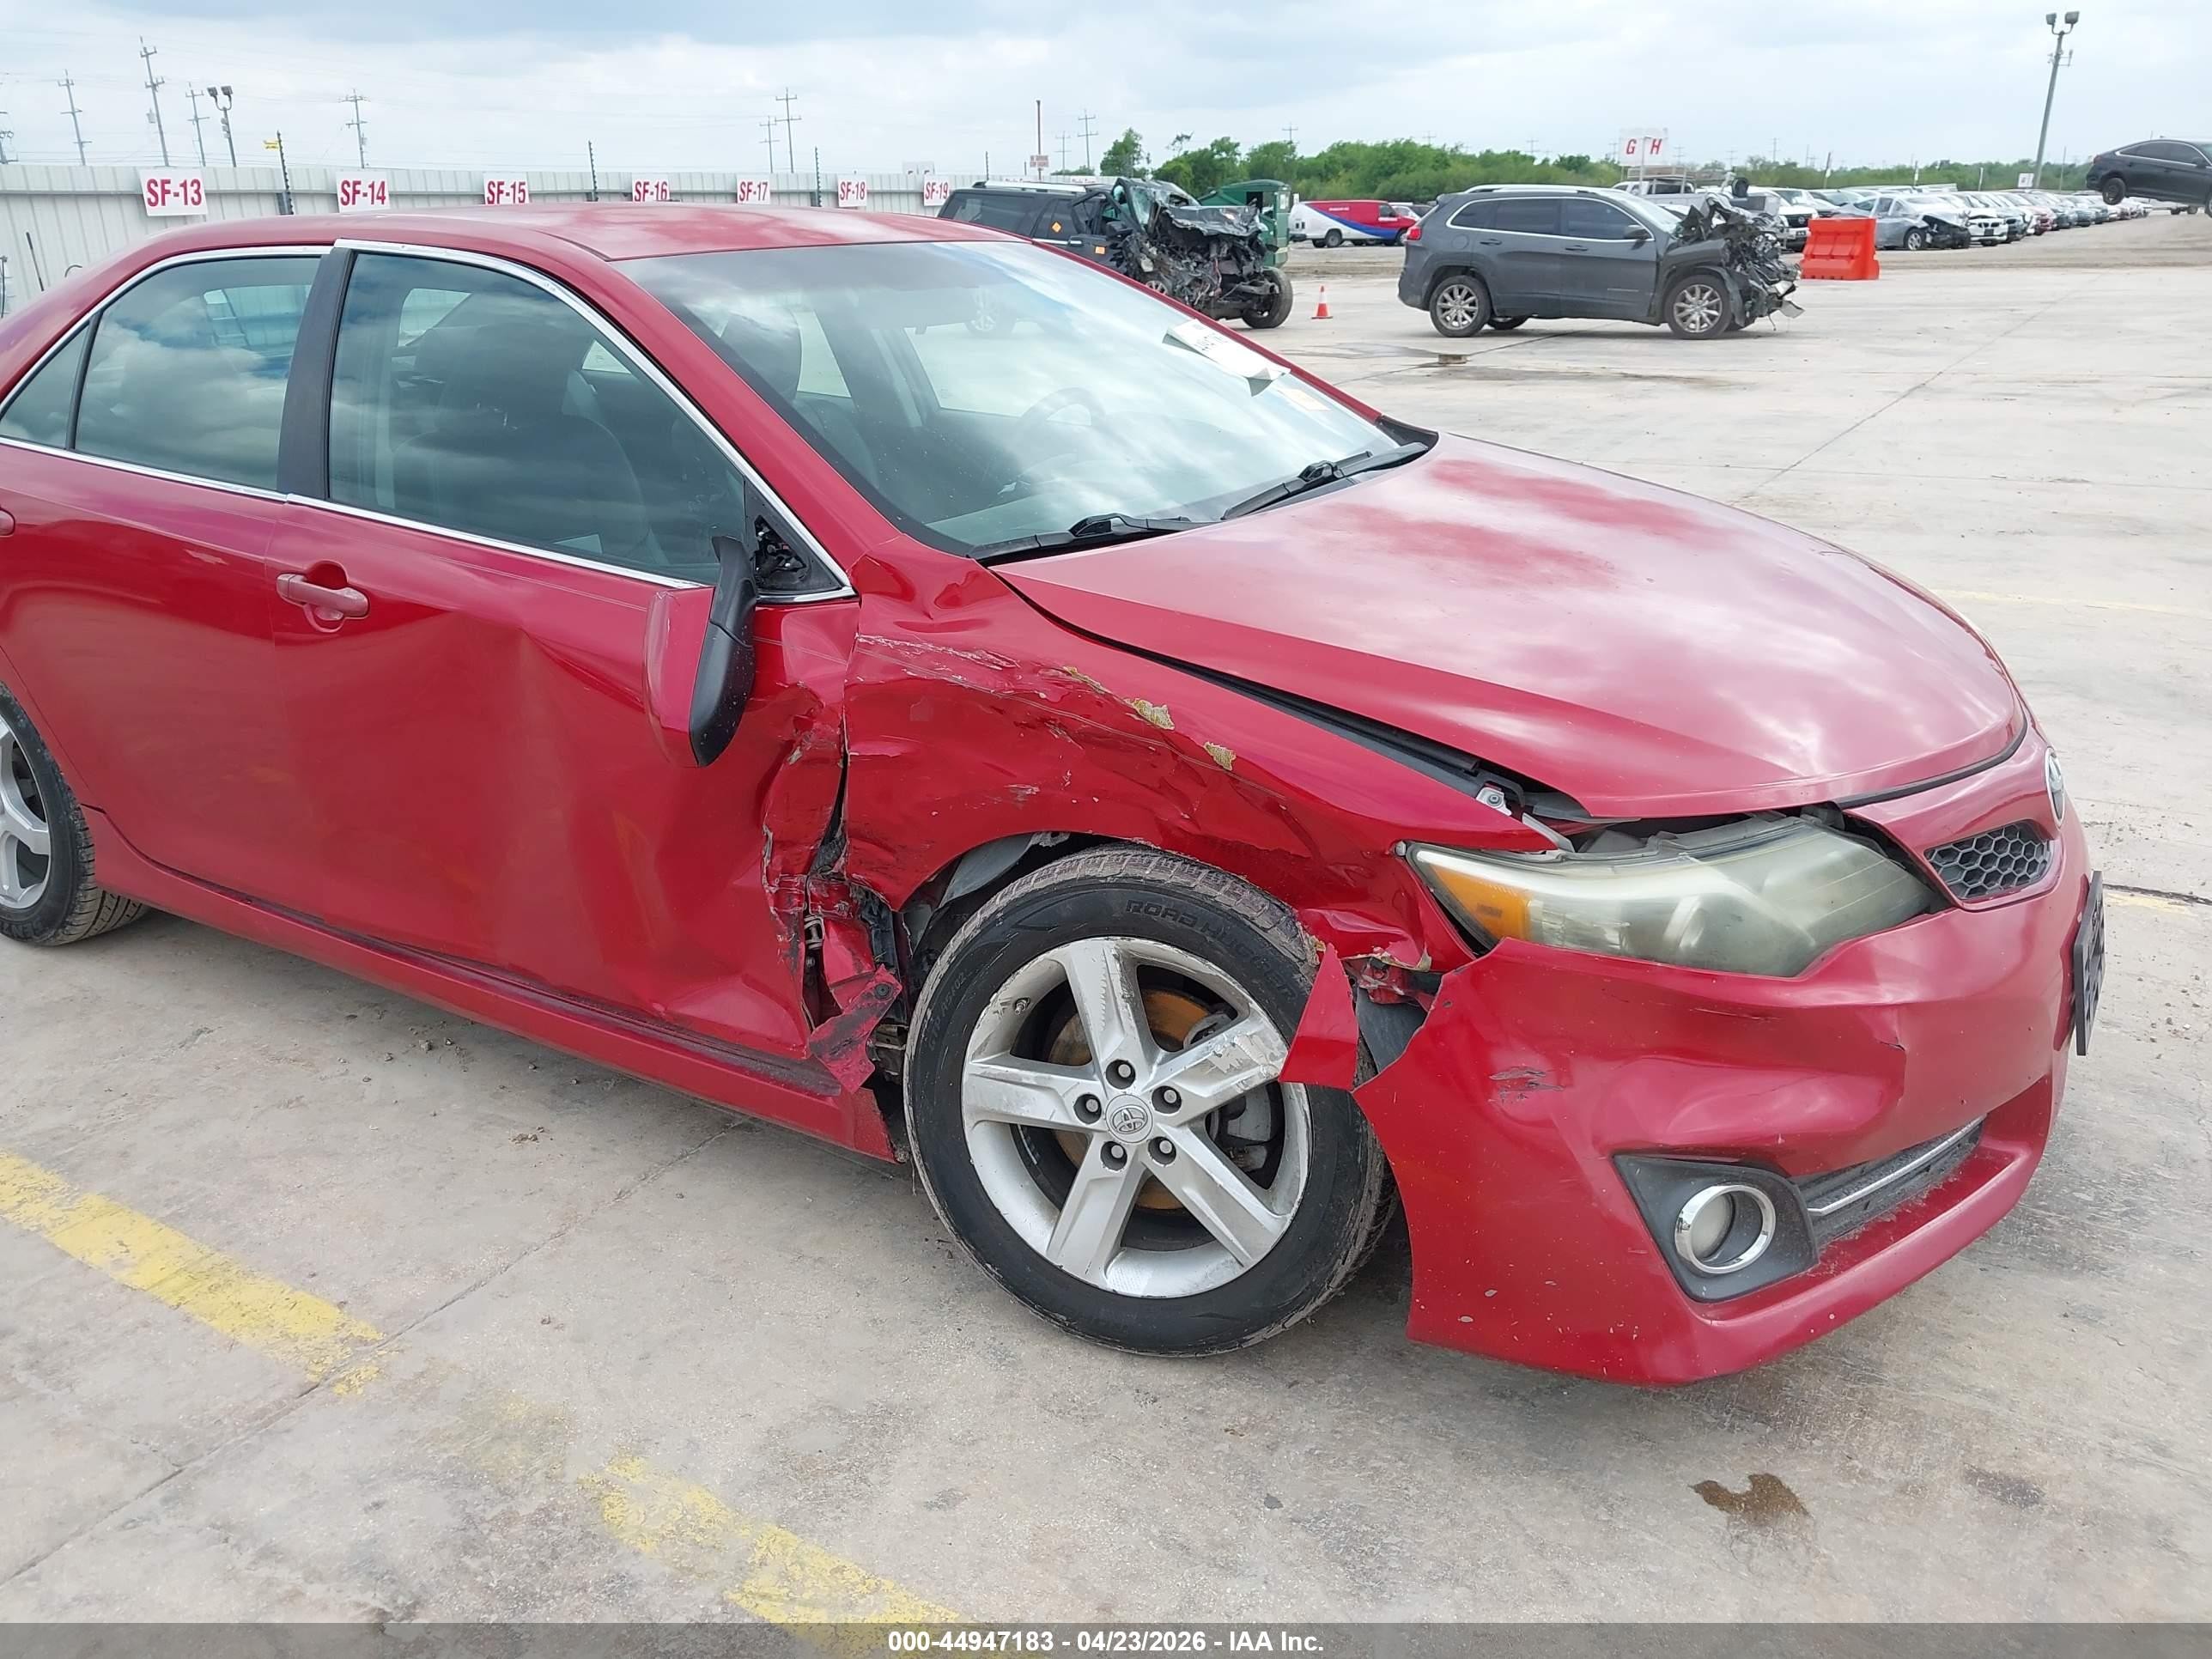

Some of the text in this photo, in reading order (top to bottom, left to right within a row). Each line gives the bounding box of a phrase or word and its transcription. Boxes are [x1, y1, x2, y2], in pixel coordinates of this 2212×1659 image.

[1626, 138, 1662, 155] G H
[146, 178, 203, 207] SF-13
[340, 179, 386, 206] SF-14
[486, 180, 526, 204] SF-15
[634, 180, 668, 202] SF-16
[738, 181, 769, 202] SF-17
[839, 180, 866, 201] SF-18
[925, 181, 949, 200] SF-19
